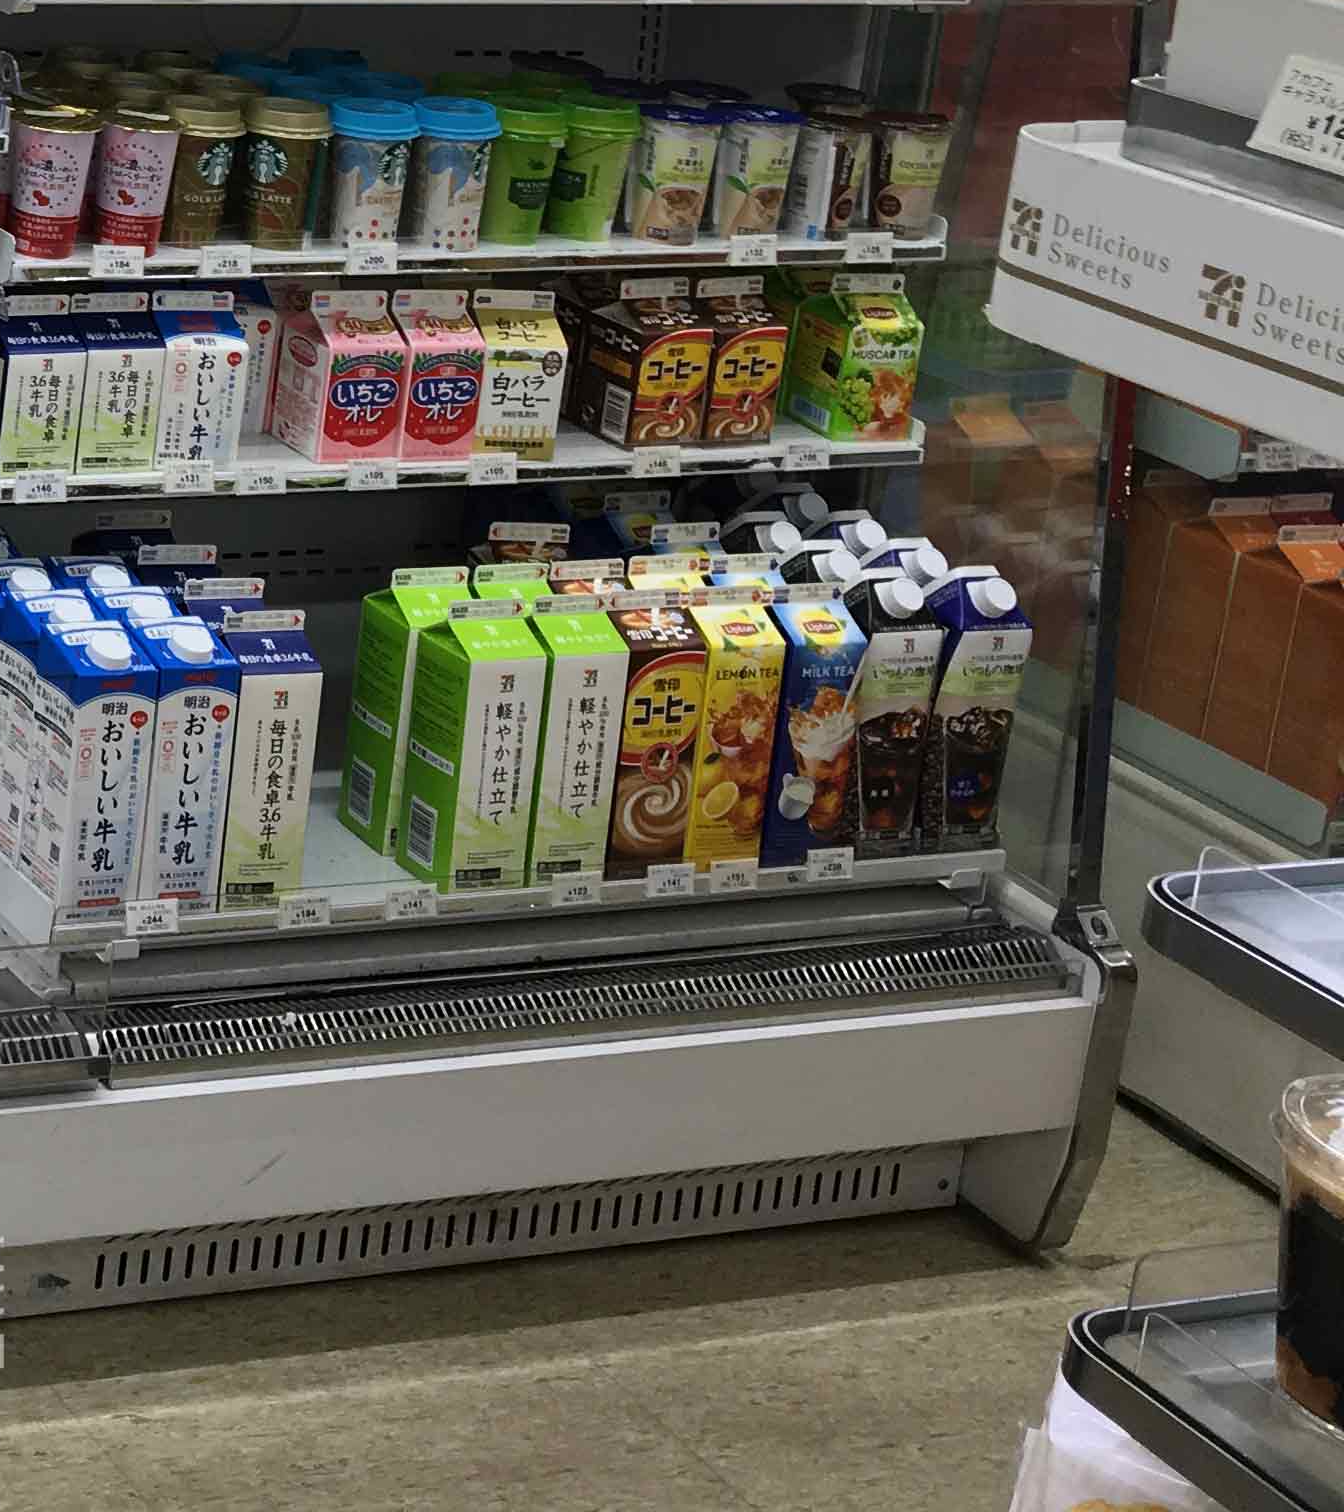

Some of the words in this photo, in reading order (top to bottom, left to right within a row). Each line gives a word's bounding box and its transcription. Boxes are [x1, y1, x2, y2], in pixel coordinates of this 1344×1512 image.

[260, 194, 294, 206] LATTE
[1052, 213, 1170, 273] Delicious
[1048, 243, 1132, 289] Sweets
[647, 360, 704, 381] コーヒー
[722, 360, 777, 381] コーヒー
[336, 383, 394, 405] いちご
[417, 383, 475, 405] いちご
[491, 374, 545, 393] 白バラ
[41, 372, 63, 445] 毎日の食卓
[188, 351, 216, 461] おいしい牛乳
[491, 393, 550, 409] コーヒー
[758, 667, 780, 680] TEA
[832, 667, 855, 679] TEA
[102, 702, 127, 715] 明治
[184, 696, 210, 708] 明治
[632, 697, 696, 726] コーヒー
[488, 703, 512, 827] 軽やか仕立て
[570, 697, 596, 818] 軽やか仕立て
[92, 720, 124, 872] おいしい牛乳
[172, 715, 206, 865] おいしい牛乳
